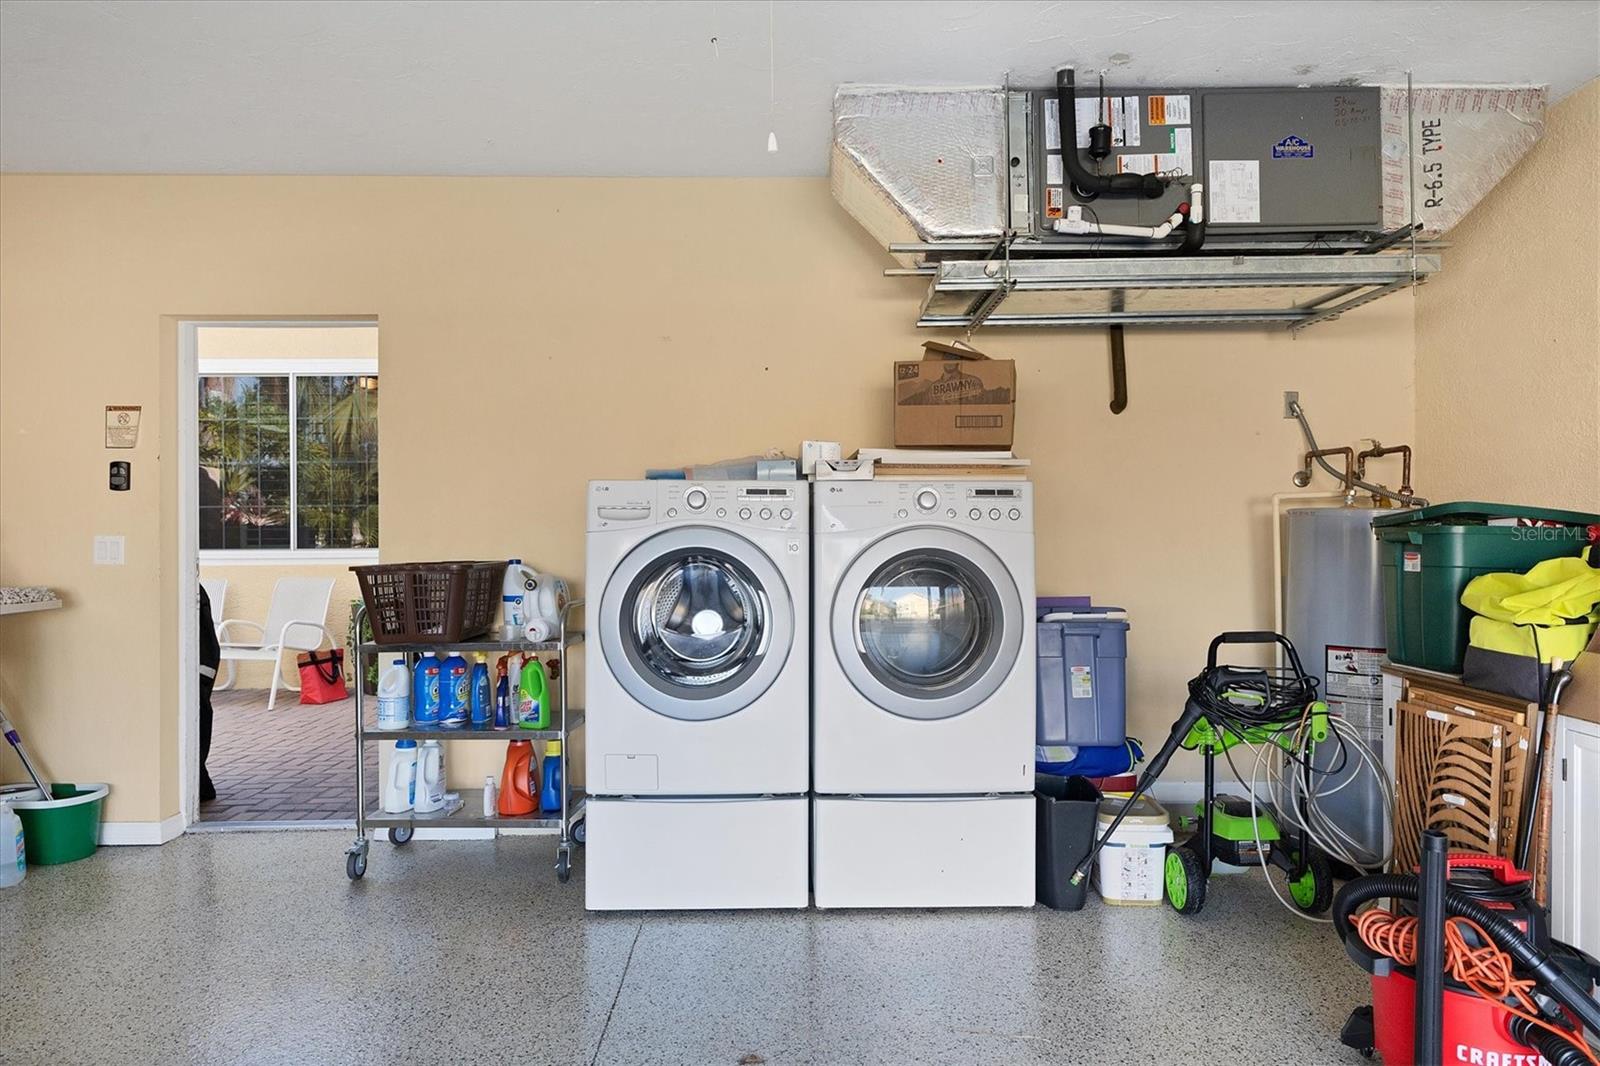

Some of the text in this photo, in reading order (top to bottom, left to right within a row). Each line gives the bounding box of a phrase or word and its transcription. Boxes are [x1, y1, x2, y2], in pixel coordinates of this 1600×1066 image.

[1422, 118, 1443, 208] R-6.5 TYPE
[933, 380, 972, 395] BRAWNY
